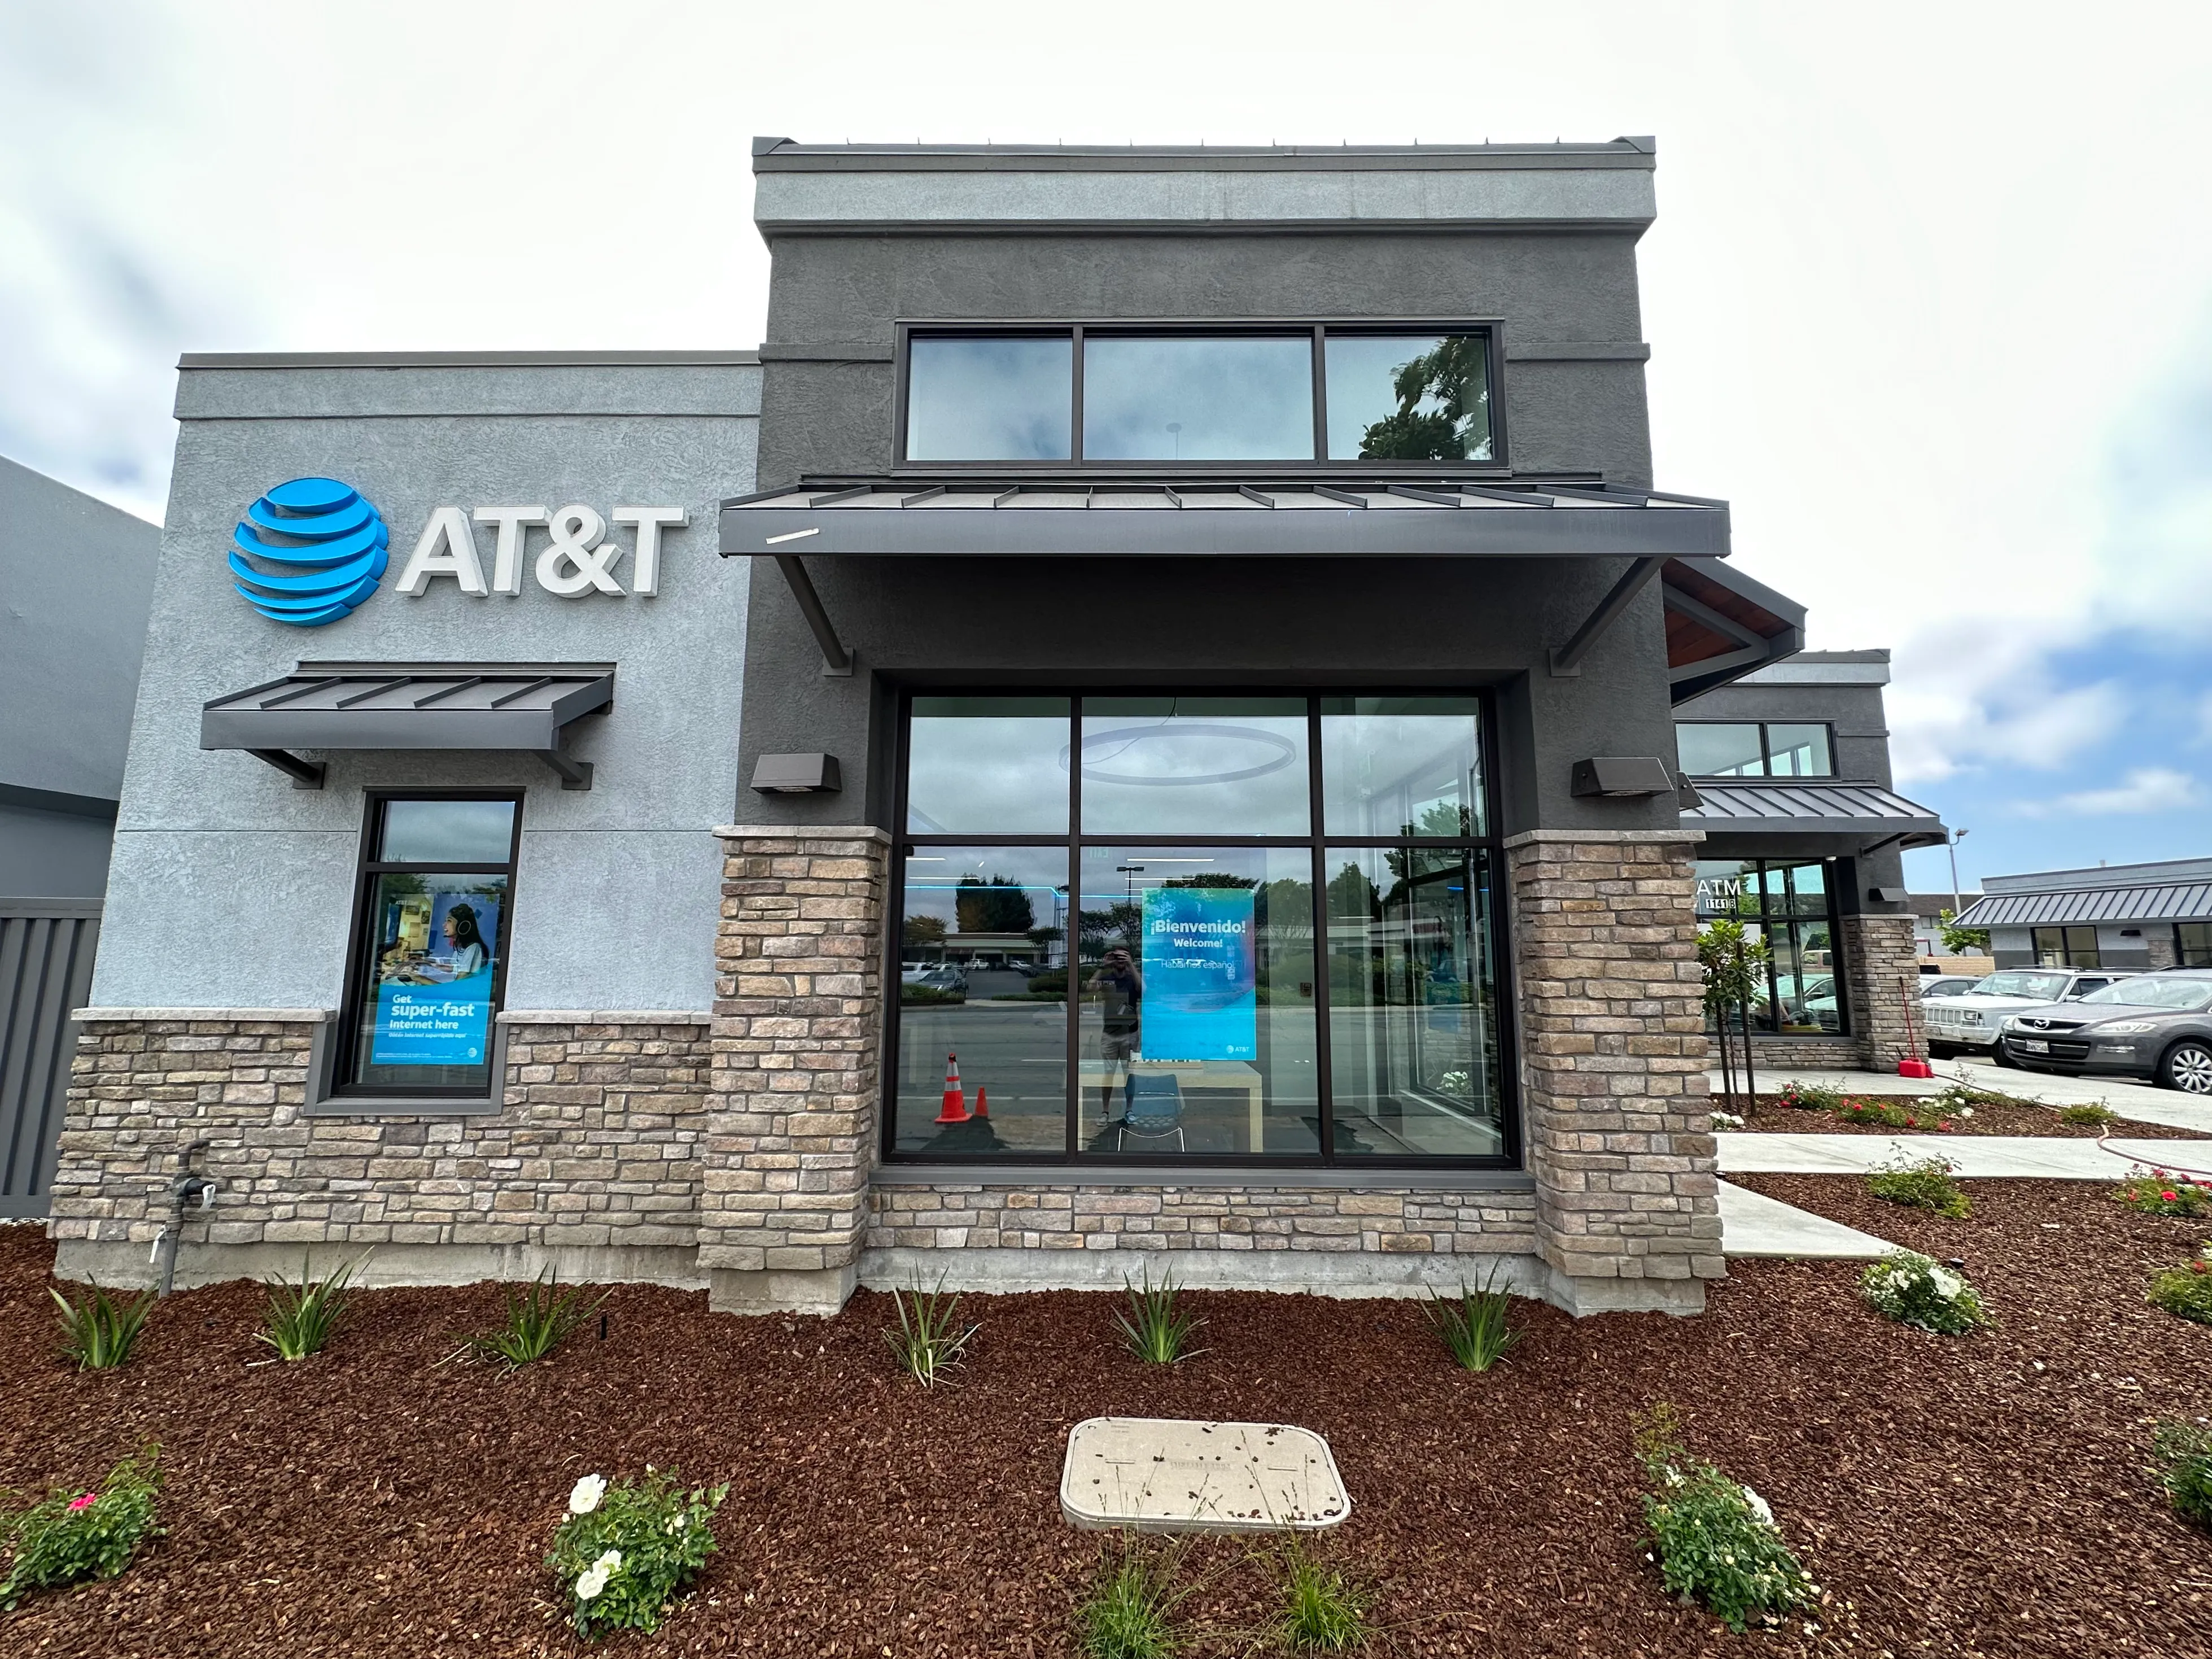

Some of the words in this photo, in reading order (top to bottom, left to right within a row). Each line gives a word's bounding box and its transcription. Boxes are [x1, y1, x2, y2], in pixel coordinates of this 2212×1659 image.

[395, 504, 689, 599] AT&T
[1697, 879, 1741, 896] ATM
[1706, 899, 1728, 908] 1141
[1730, 899, 1735, 908] B
[1151, 919, 1245, 935] ¡Bienvenido!
[1173, 938, 1223, 948] Welcome!
[1161, 960, 1201, 968] Hablamos
[392, 994, 412, 1003] Get
[391, 1002, 475, 1019] super-fast
[390, 1020, 432, 1029] Internet
[435, 1019, 459, 1029] here
